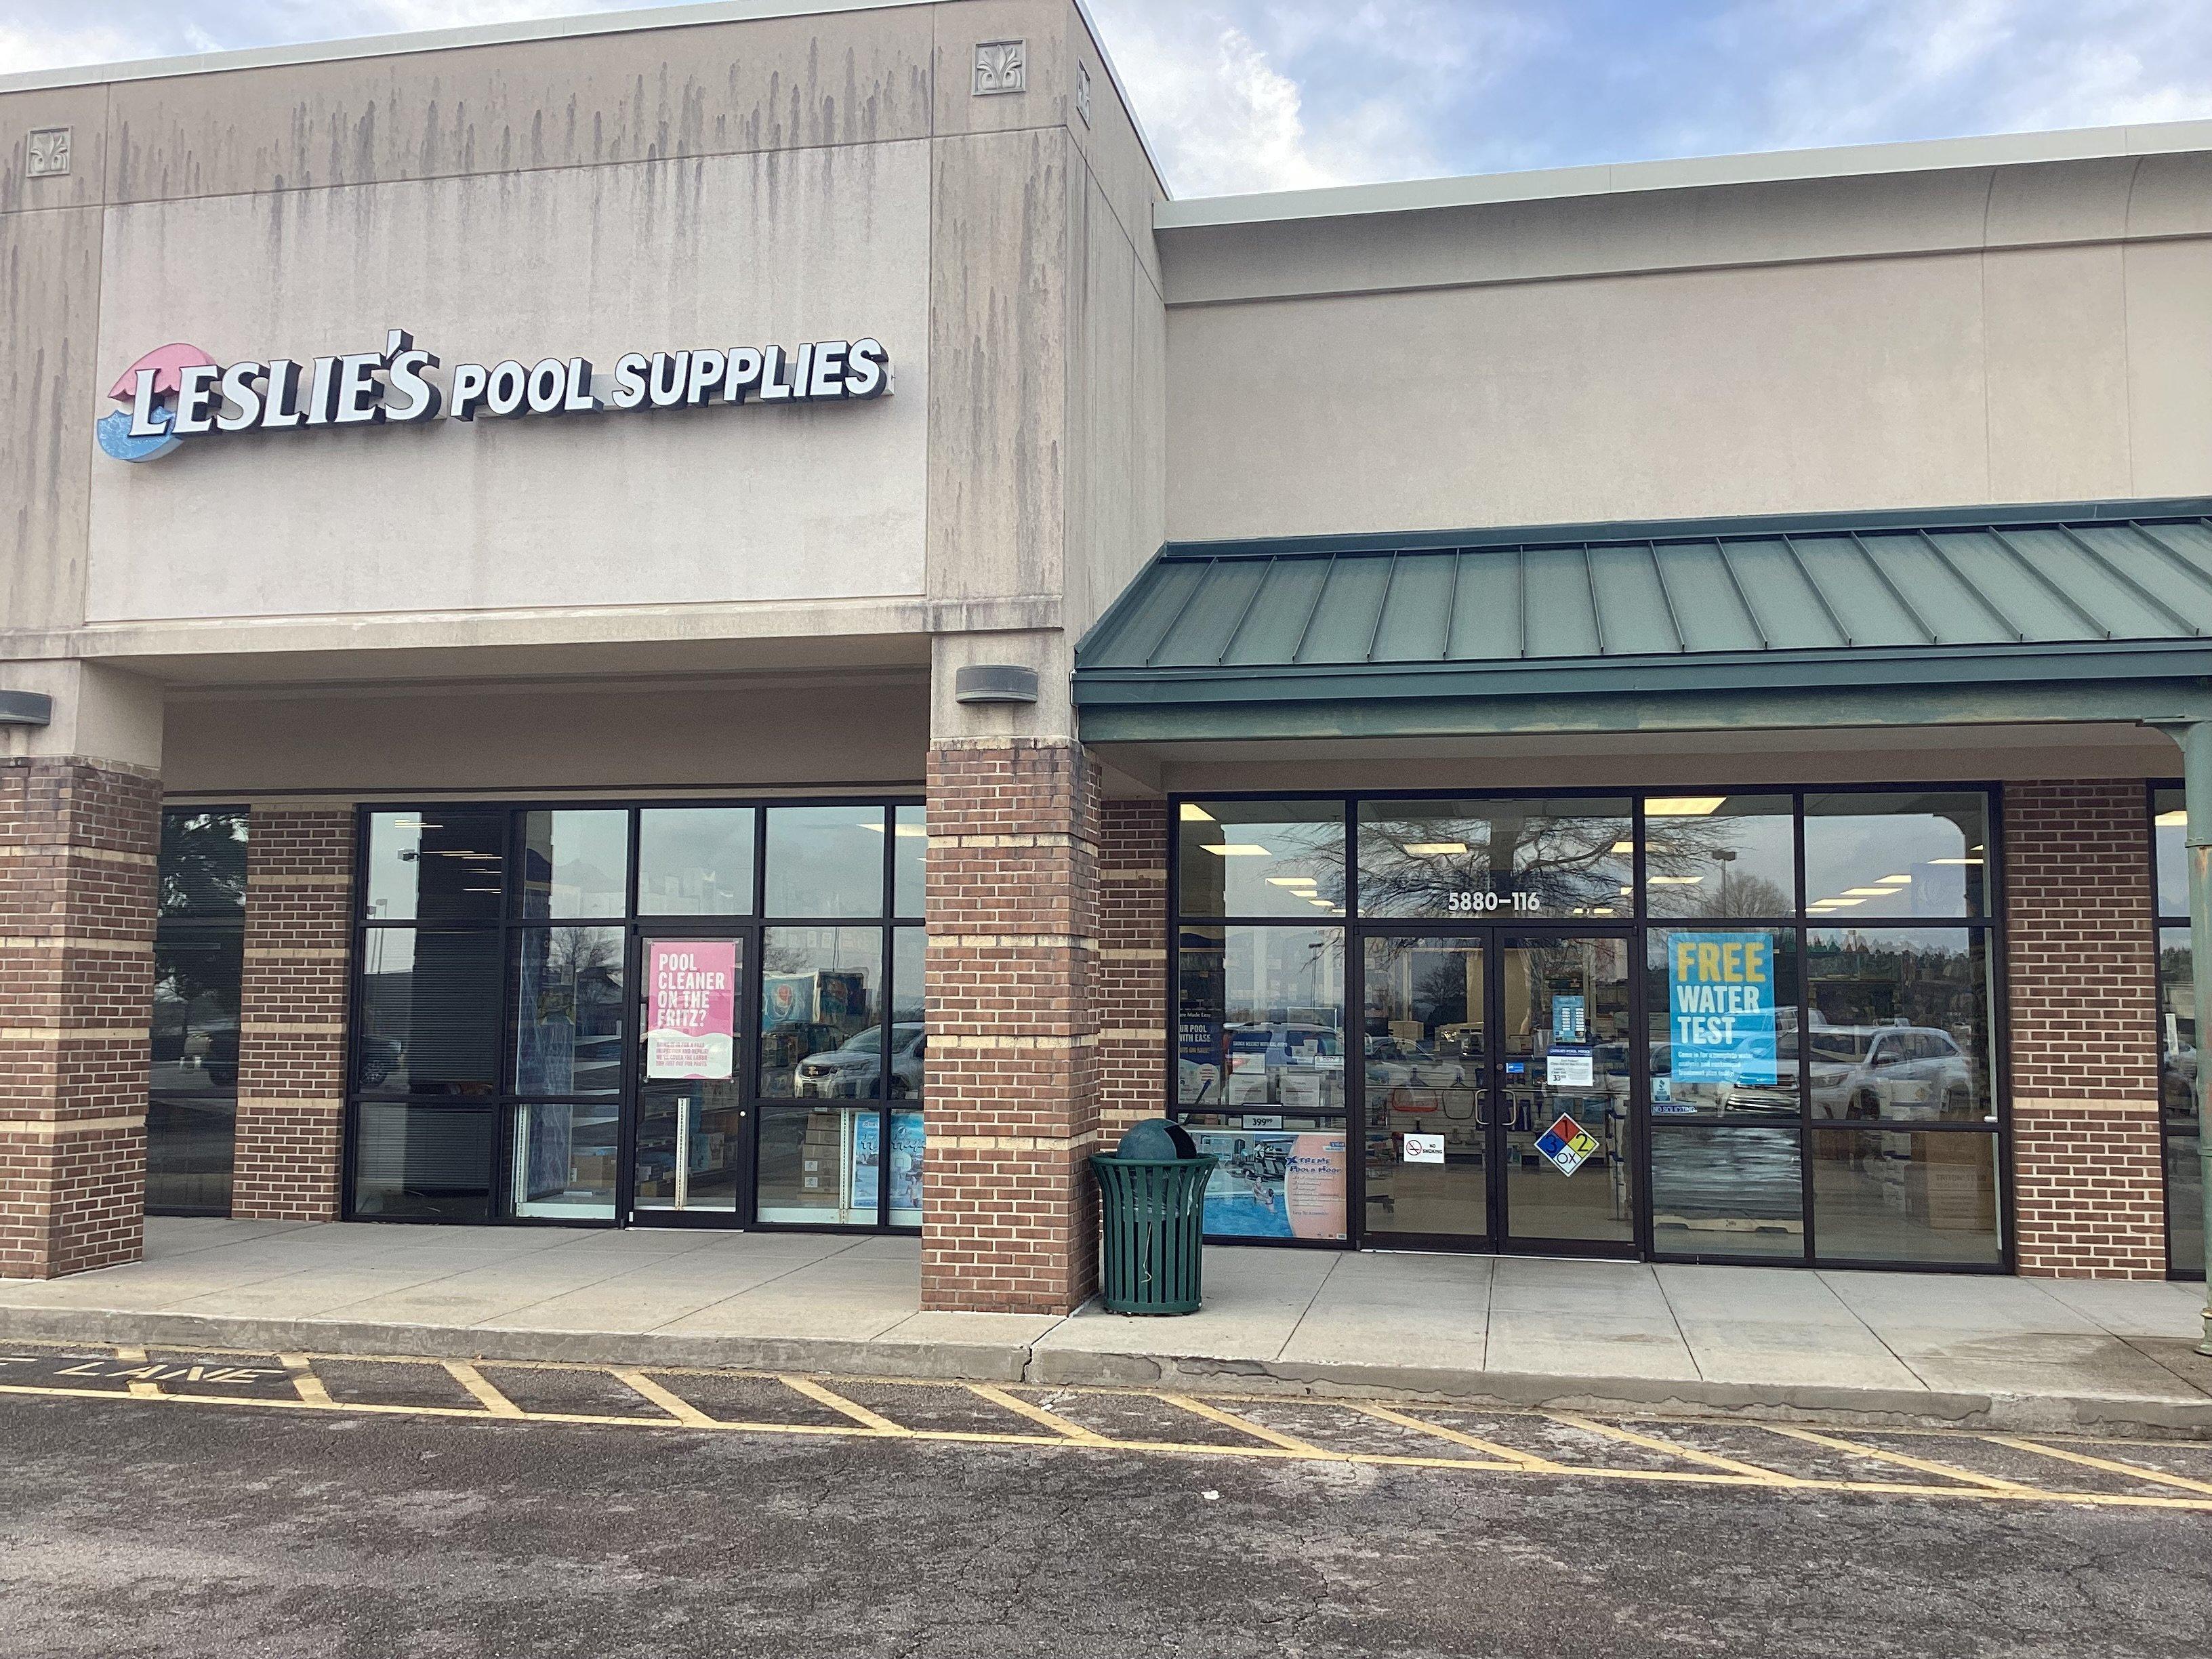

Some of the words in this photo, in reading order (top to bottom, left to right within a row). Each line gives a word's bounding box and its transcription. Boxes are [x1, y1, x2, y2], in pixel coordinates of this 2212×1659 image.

[127, 329, 439, 437] LESLIE'S
[450, 357, 598, 418] POOL
[611, 337, 885, 409] SUPPLIES
[1448, 891, 1540, 911] 5880-116
[659, 953, 697, 971] POOL
[1677, 941, 1766, 982] FREE
[657, 972, 725, 990] CLEANER
[657, 990, 678, 1009] ON
[683, 990, 710, 1009] THE
[1676, 985, 1761, 1014] WATER
[656, 1008, 708, 1027] FRITZ?
[1189, 1024, 1208, 1033] POOL
[1194, 1033, 1211, 1042] EASE
[1677, 1016, 1736, 1044] TEST
[1562, 1120, 1568, 1139] 1
[1544, 1134, 1557, 1154] 3
[1576, 1132, 1589, 1152] 2
[1557, 1152, 1577, 1164] OX
[53, 1361, 285, 1384] LANE
